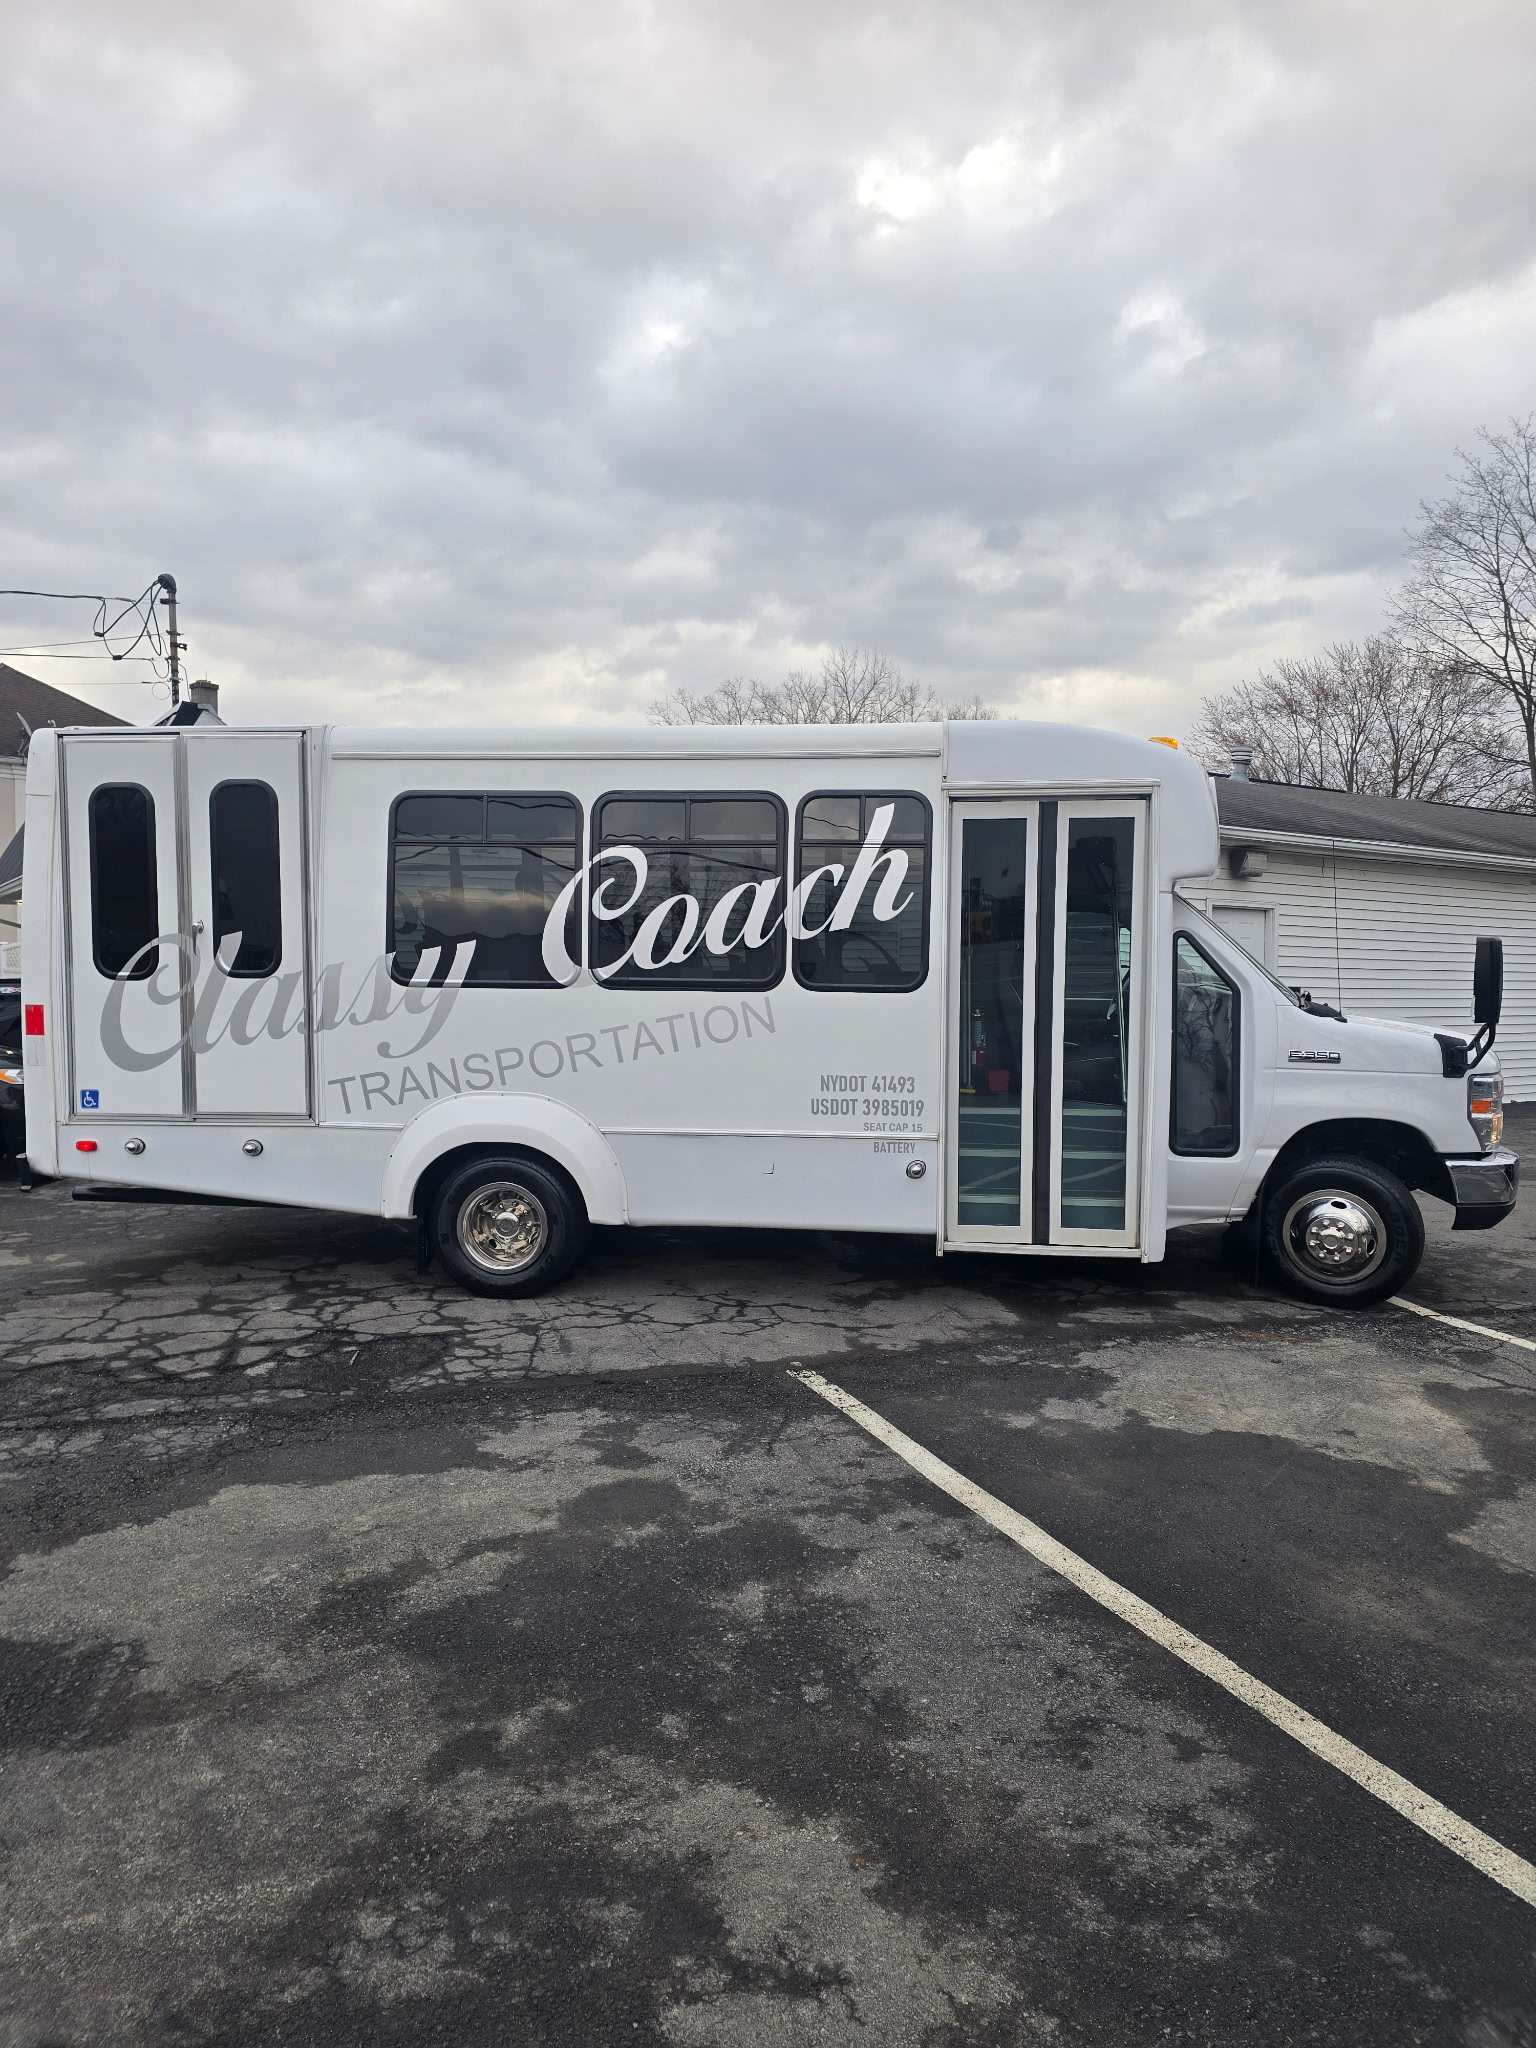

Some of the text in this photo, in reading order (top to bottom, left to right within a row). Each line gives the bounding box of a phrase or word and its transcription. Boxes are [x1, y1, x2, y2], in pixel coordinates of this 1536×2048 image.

[100, 803, 914, 1073] Classy Coach
[328, 996, 777, 1115] TRANSPORTATION
[820, 1074, 915, 1094] NYDOT 41493
[811, 1098, 925, 1117] USDOT 3985019
[863, 1122, 923, 1133] SEAT CAP 15
[873, 1141, 916, 1153] BATTERY
